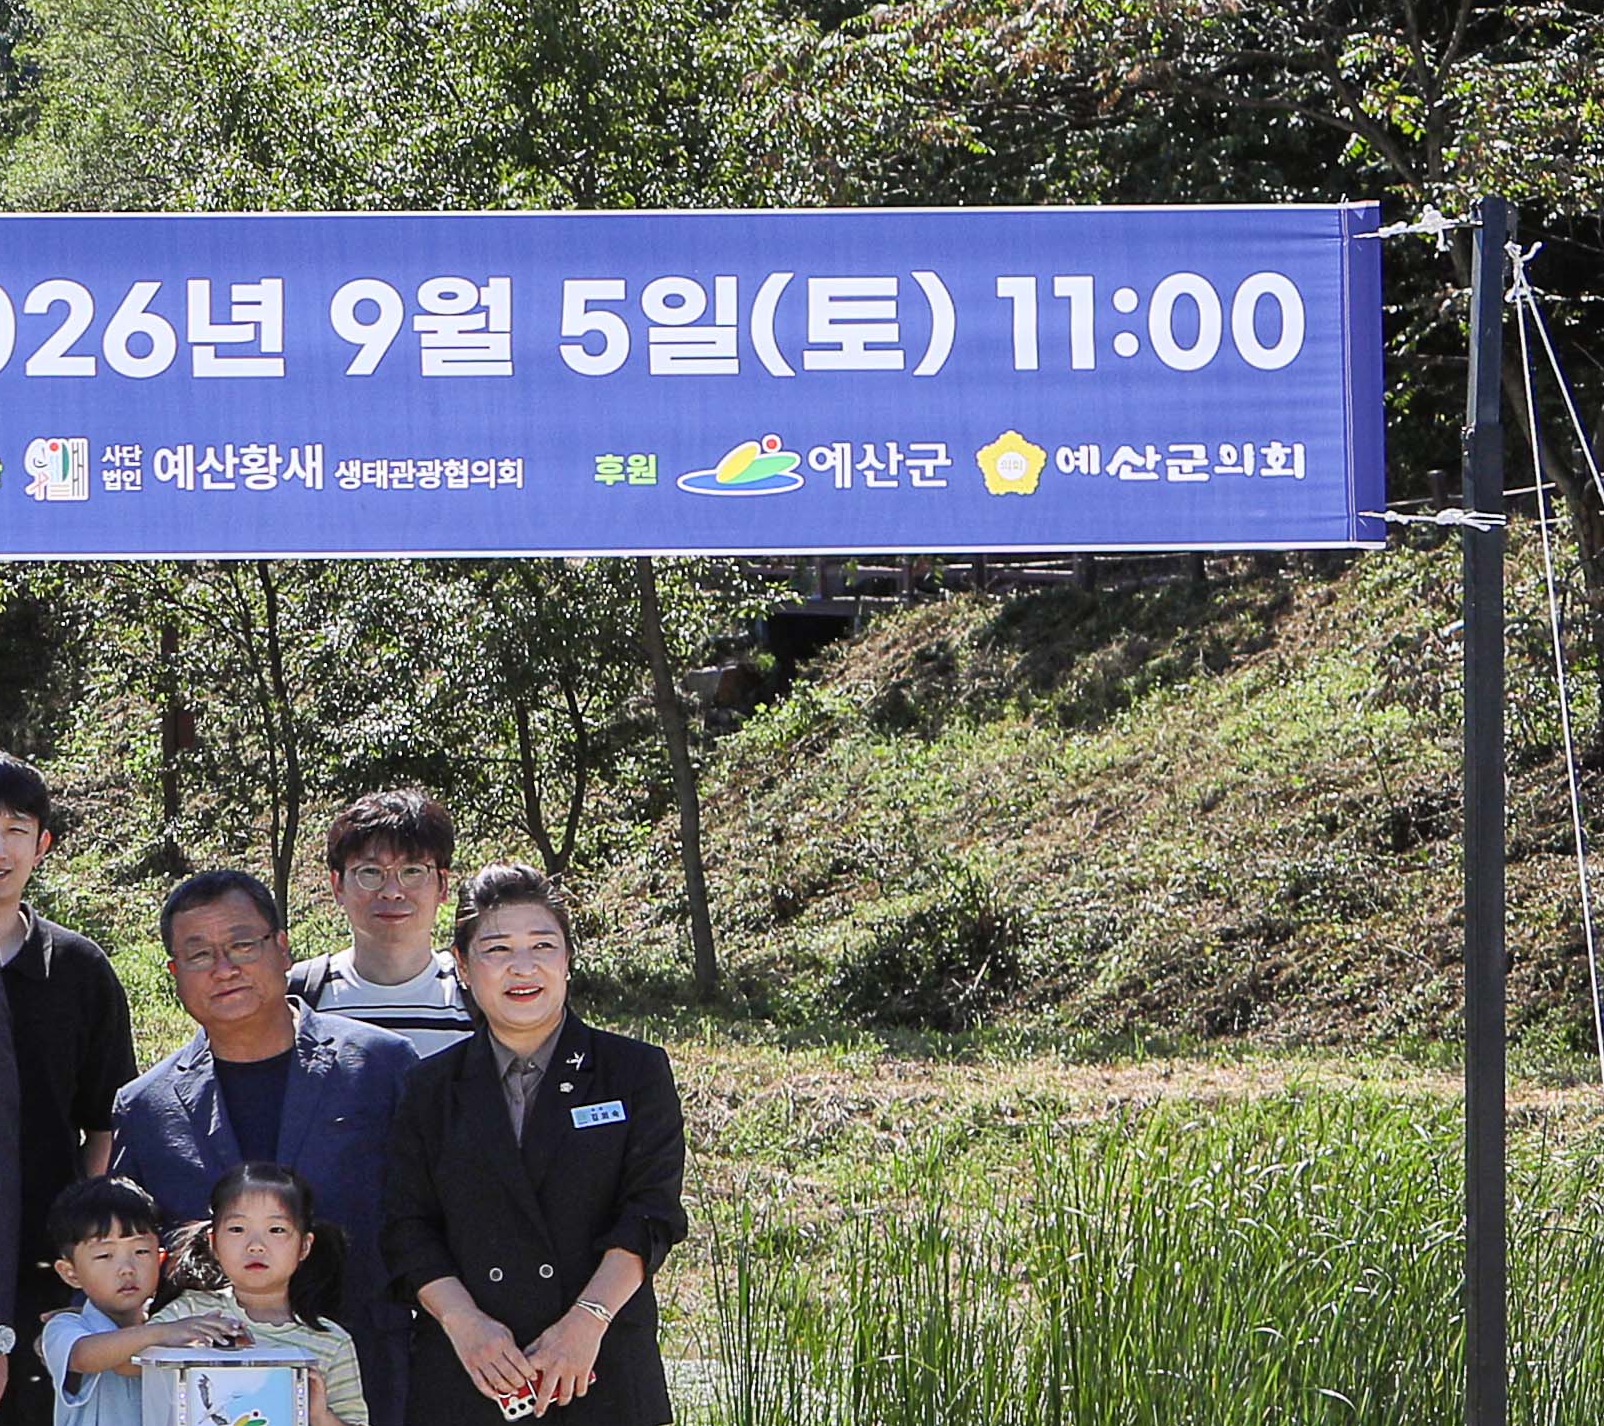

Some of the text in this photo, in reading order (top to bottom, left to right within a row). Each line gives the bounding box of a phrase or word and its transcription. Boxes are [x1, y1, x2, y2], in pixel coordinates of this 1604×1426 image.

[329, 276, 515, 377] 9월
[559, 271, 957, 378] 5일(토)
[993, 271, 1306, 372] 11:00
[100, 445, 142, 466] 사단
[153, 445, 524, 491] 예산황새 생태관광협의회
[594, 454, 657, 485] 후원
[808, 441, 953, 489] 예산군
[1055, 441, 1306, 483] 예산군의회
[102, 469, 142, 491] 법인
